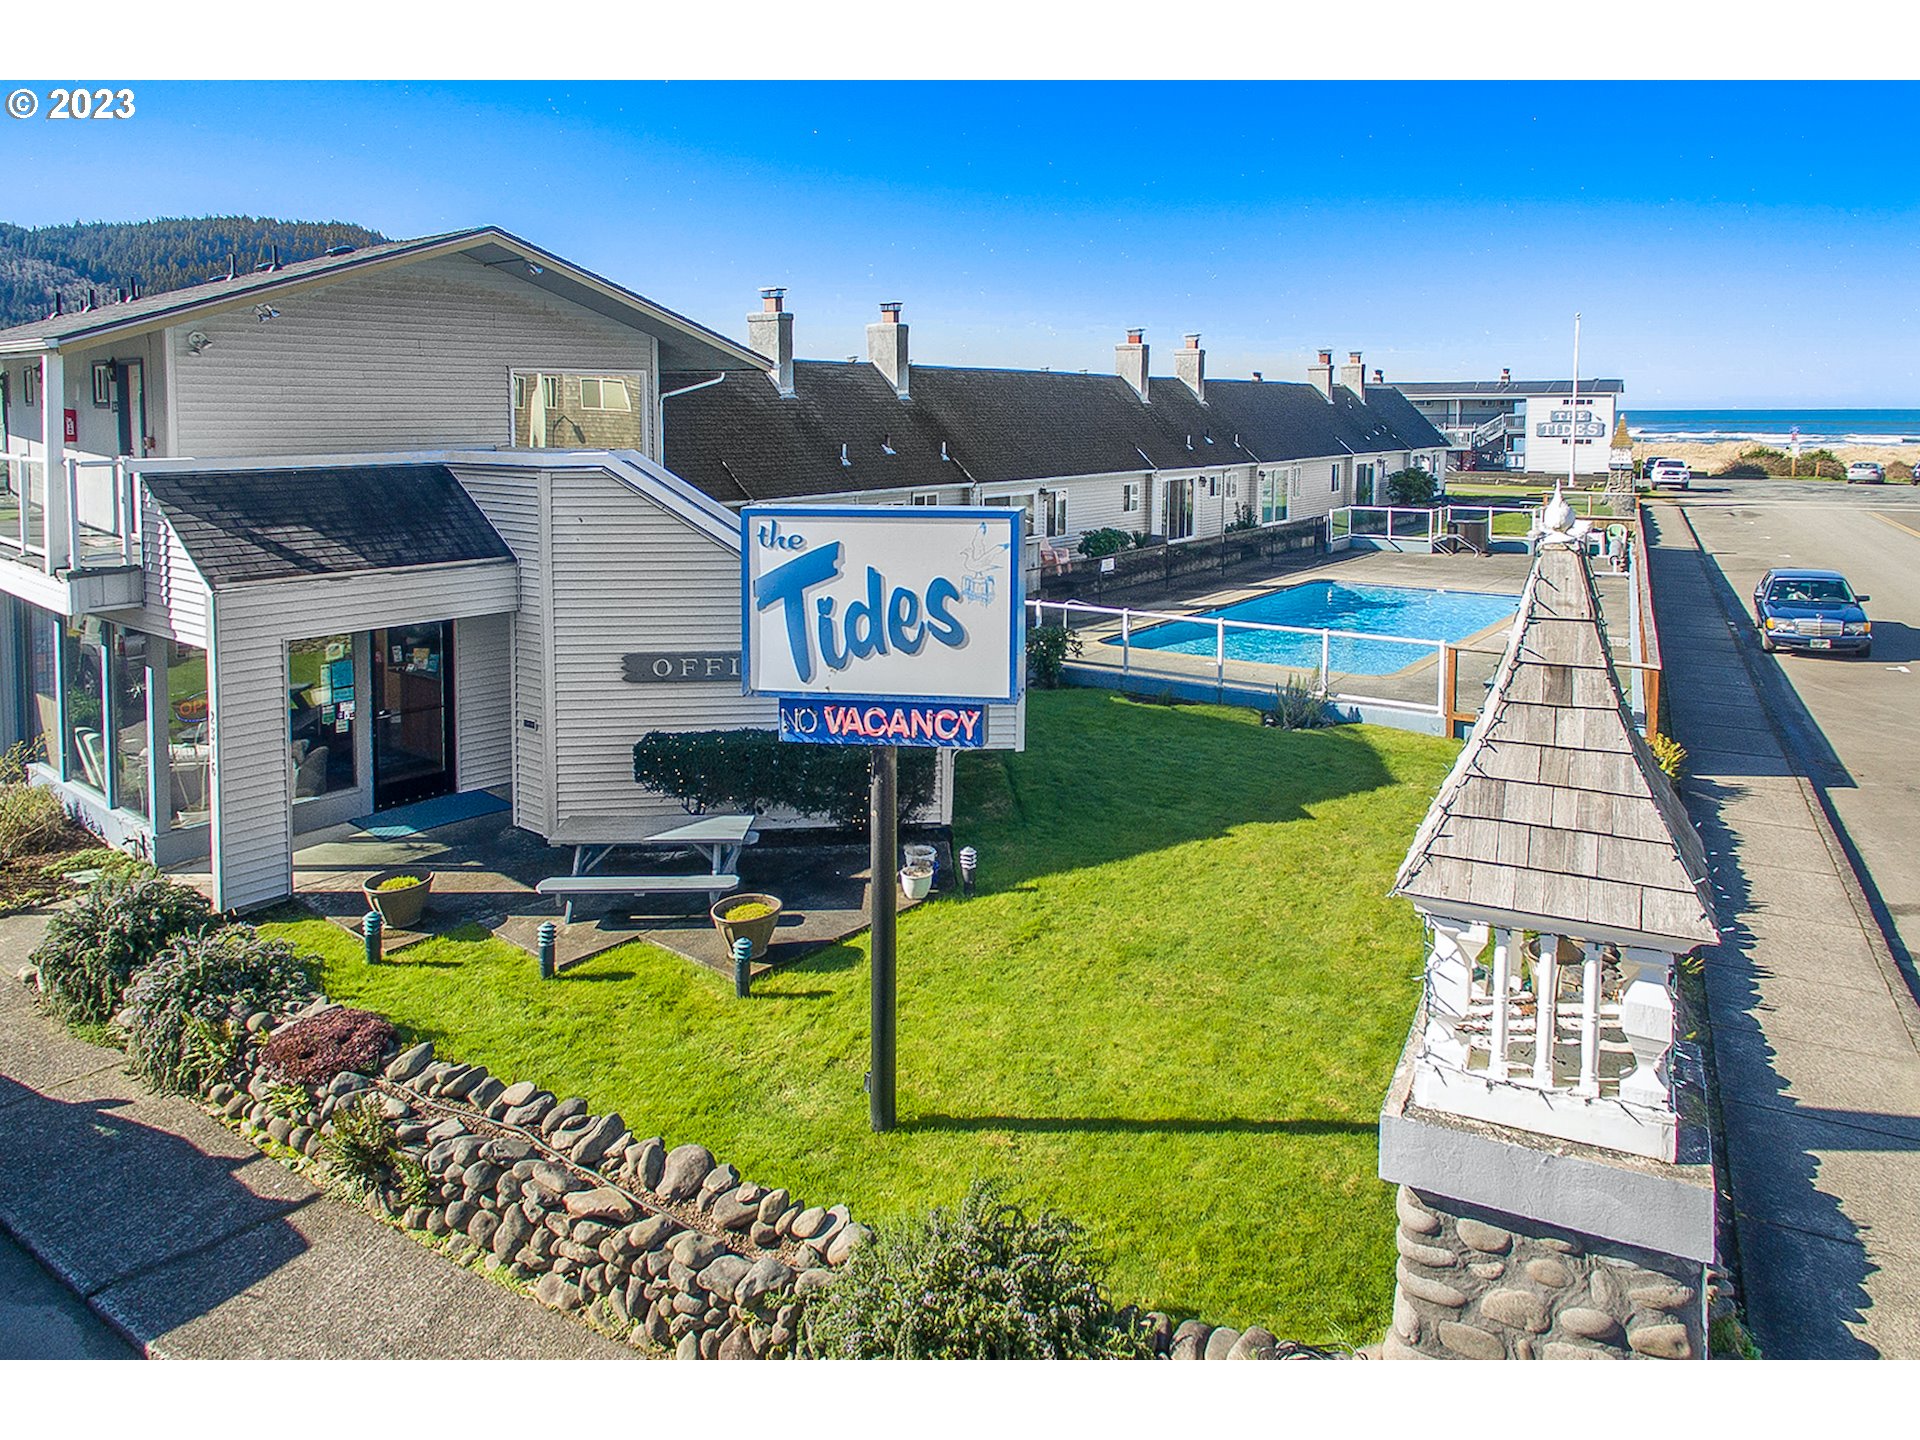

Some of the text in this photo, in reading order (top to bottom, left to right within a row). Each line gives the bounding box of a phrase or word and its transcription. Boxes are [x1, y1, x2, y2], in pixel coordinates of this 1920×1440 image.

[1555, 411, 1585, 420] THE
[1541, 423, 1598, 436] TIDES
[757, 519, 805, 549] the
[754, 541, 966, 684] Tides
[652, 658, 740, 677] OFFI
[780, 706, 981, 740] NO VACANCY
